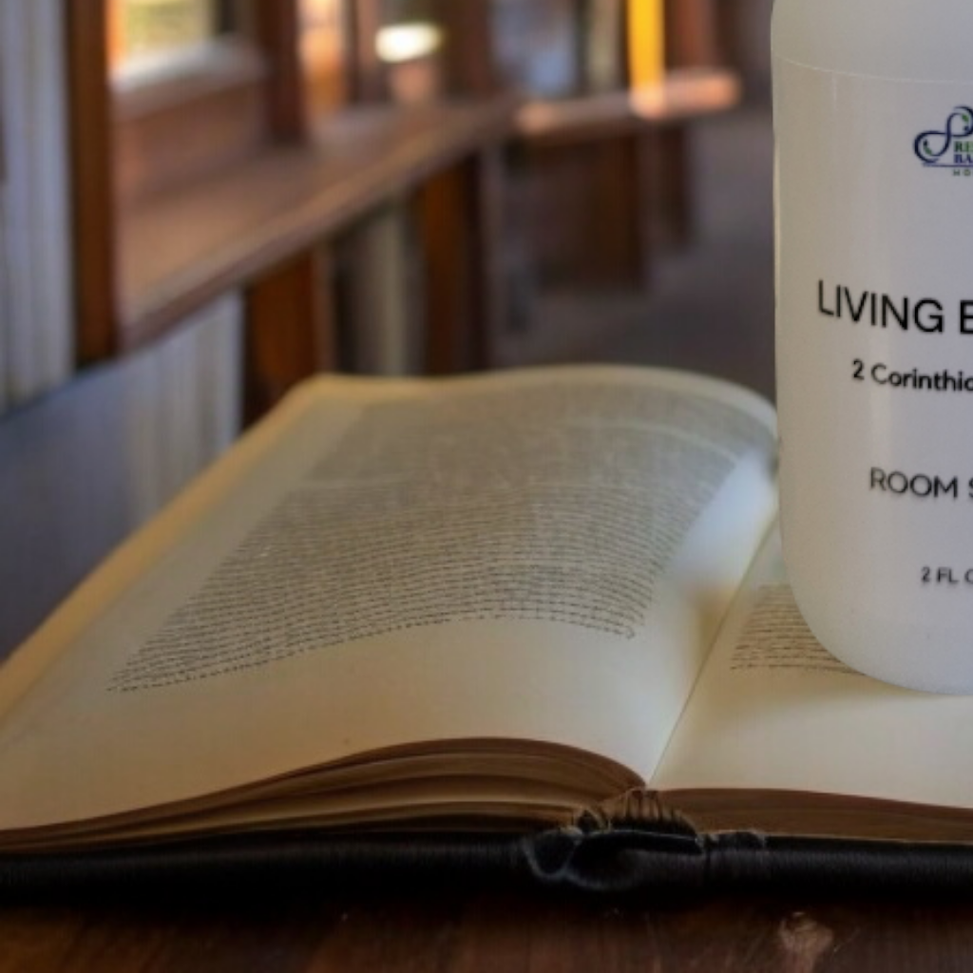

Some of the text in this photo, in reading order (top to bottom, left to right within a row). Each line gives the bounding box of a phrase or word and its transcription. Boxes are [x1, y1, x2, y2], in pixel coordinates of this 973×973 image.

[817, 279, 945, 335] LIVING
[851, 358, 865, 382] 2
[869, 466, 959, 501] ROOM
[920, 566, 931, 586] 2
[935, 567, 959, 586] FL
